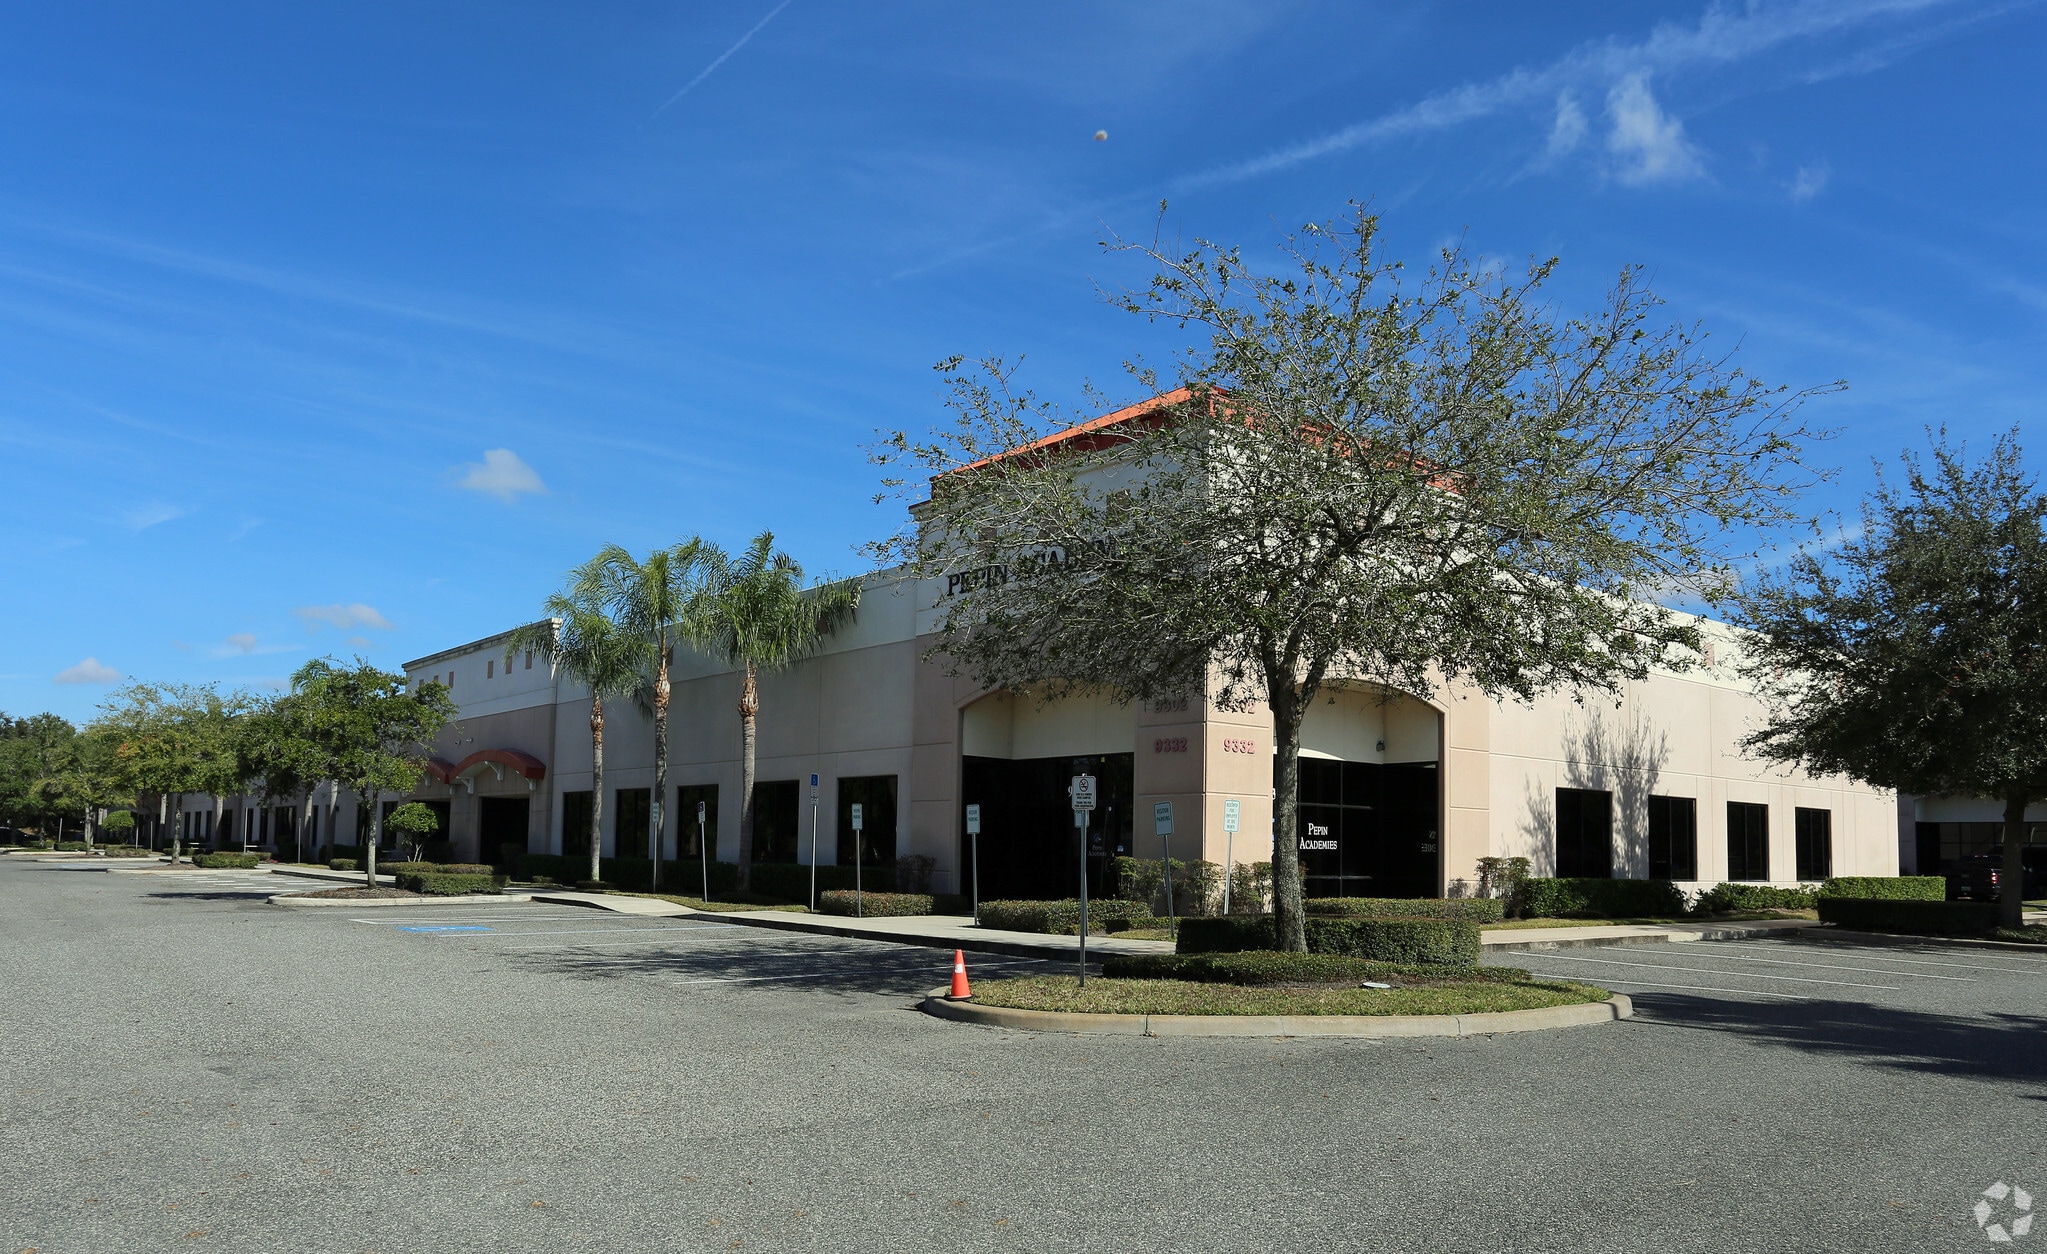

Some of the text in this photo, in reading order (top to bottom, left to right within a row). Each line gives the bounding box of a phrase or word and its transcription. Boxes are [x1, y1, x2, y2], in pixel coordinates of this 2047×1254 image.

[947, 564, 1008, 597] PEPIN
[1153, 737, 1188, 753] 9332
[1223, 738, 1256, 755] 9332
[1299, 836, 1338, 850] ACADEMIES
